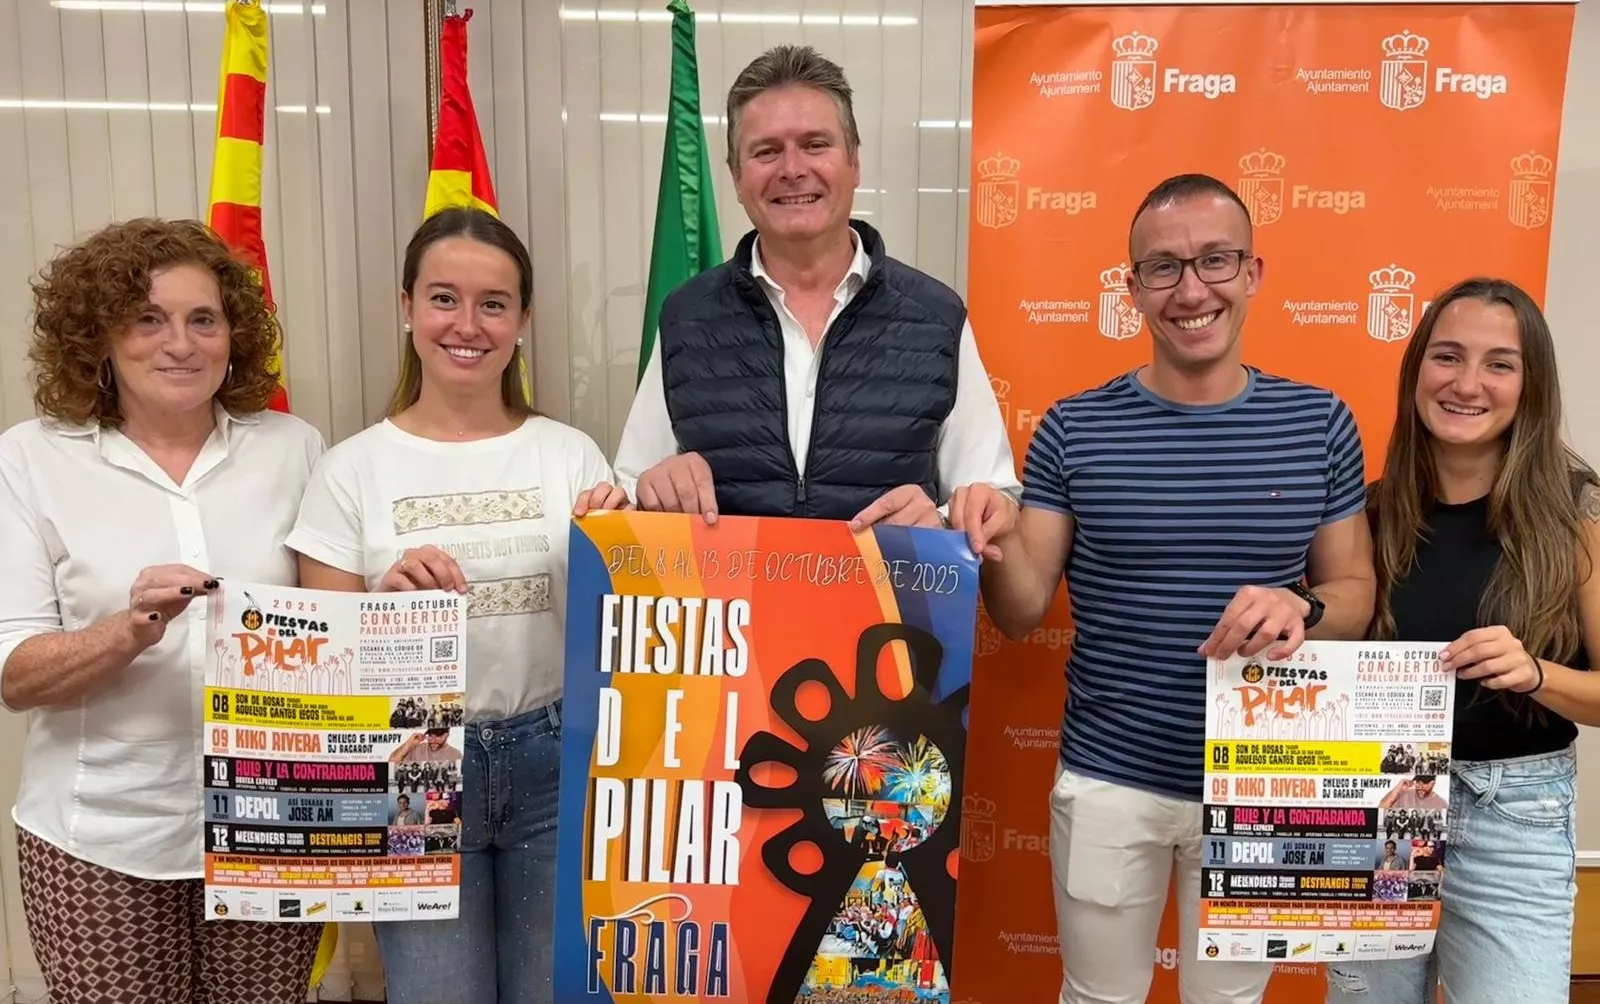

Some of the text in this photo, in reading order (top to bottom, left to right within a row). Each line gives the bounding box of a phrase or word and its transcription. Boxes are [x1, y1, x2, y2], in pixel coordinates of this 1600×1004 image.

[1029, 69, 1103, 85] Ayuntamiento
[1296, 67, 1371, 83] Ayuntamiento
[1435, 67, 1507, 99] Fraga
[1039, 82, 1101, 98] Ajuntament
[1163, 68, 1237, 99] Fraga
[1306, 81, 1370, 96] Ajuntament
[1026, 187, 1097, 215] Fraga
[1292, 185, 1366, 215] Fraga
[1426, 186, 1500, 201] Ayuntamiento
[1436, 198, 1499, 212] Ajuntament
[1019, 299, 1091, 312] Ayuntamiento
[1282, 299, 1359, 312] Ayuntamiento
[1028, 311, 1089, 325] Ajuntament
[1292, 312, 1357, 326] Ajuntament
[494, 537, 513, 558] NOT
[515, 534, 550, 554] THINGS
[607, 545, 960, 595] DEL 8 AL 13 DE OCTUBRE DE 2025
[273, 599, 318, 612] 2025
[360, 599, 459, 611] FRAGA OCTUBRE
[265, 613, 329, 633] FIESTAS
[360, 609, 459, 626] CONCIERTOS
[278, 627, 297, 637] DEL
[411, 625, 427, 634] DEL
[599, 594, 751, 677] FIESTAS
[1022, 628, 1073, 650] aga
[1286, 653, 1318, 662] 025
[1358, 651, 1438, 660] FRAGA OCTUB
[1266, 666, 1328, 681] FIESTAS
[1357, 661, 1440, 673] CONCIERTO
[1279, 679, 1298, 687] DEL
[1403, 674, 1418, 683] DEL
[212, 694, 229, 713] 08
[235, 694, 248, 704] SON
[251, 695, 260, 705] DE
[262, 696, 285, 707] ROSAS
[597, 687, 741, 770] DEL
[1004, 725, 1060, 738] Ayuntamien
[212, 728, 229, 747] 09
[235, 728, 322, 754] KIKO RIVERA
[1013, 738, 1060, 750] Ajuntame
[327, 744, 338, 753] DJ
[1213, 746, 1229, 764] 08
[1235, 744, 1248, 754] SON
[1251, 745, 1260, 754] DE
[1262, 745, 1284, 755] ROSAS
[211, 761, 229, 780] 10
[264, 762, 273, 778] Y
[276, 763, 290, 779] LA
[293, 763, 377, 781] CONTRABANDA
[1212, 777, 1228, 796] 09
[1235, 777, 1317, 798] KIKO RIVERA
[1322, 789, 1331, 798] DJ
[213, 794, 229, 814] 11
[235, 796, 280, 820] DEPOL
[288, 807, 314, 822] JOSE
[317, 808, 334, 822] AM
[1210, 810, 1227, 828] 10
[1262, 808, 1271, 824] Y
[1273, 809, 1286, 825] LA
[1289, 809, 1366, 826] CONTRABANDA
[212, 828, 229, 846] 12
[309, 833, 363, 846] DESTRANGIS
[592, 777, 743, 886] PILAR
[1002, 829, 1050, 857] Frag
[1210, 841, 1226, 859] 11
[1232, 841, 1274, 864] DEPOL
[1282, 850, 1307, 865] JOSE
[1309, 850, 1325, 865] AM
[1209, 874, 1224, 891] 12
[1301, 876, 1350, 889] DESTRANGIS
[417, 902, 452, 911] WeAre!
[998, 931, 1060, 943] Ayuntamient
[1008, 942, 1061, 954] Ajuntamen
[1394, 943, 1427, 952] WeAre!
[587, 916, 731, 997] FRAGA
